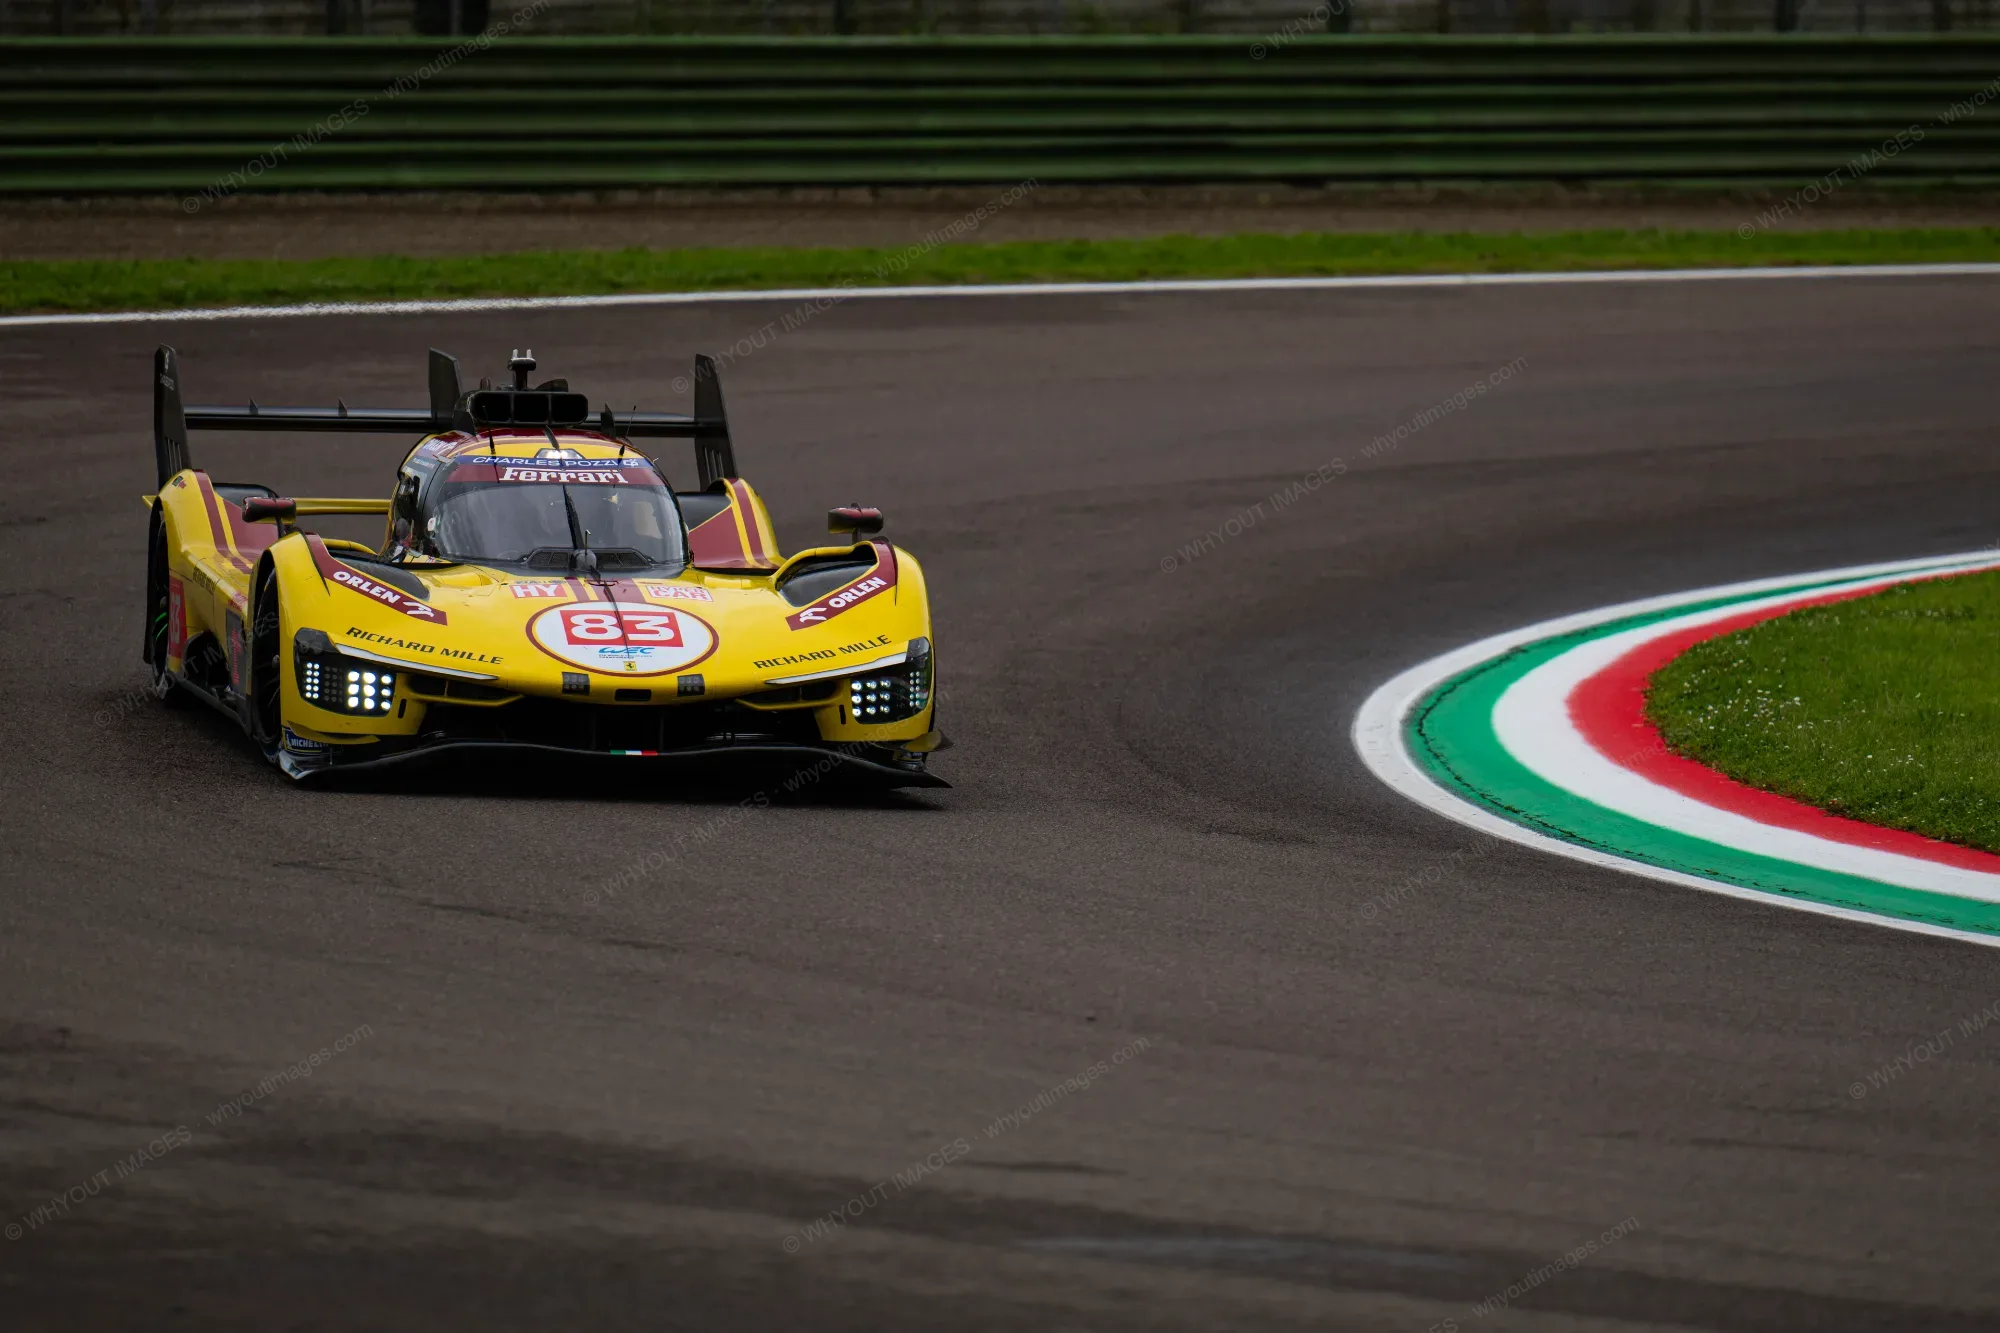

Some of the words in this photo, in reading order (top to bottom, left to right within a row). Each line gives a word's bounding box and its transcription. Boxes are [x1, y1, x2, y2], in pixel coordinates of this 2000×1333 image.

[473, 456, 560, 467] CHARLES
[499, 467, 629, 484] Ferrari
[333, 571, 401, 604] ORLEN
[513, 585, 559, 597] HY
[828, 576, 887, 608] ORLEN
[570, 613, 675, 641] 83
[346, 626, 435, 654] RICHARD
[440, 648, 504, 665] MILLE
[753, 649, 837, 669] RICHARD
[838, 634, 892, 655] MILLE
